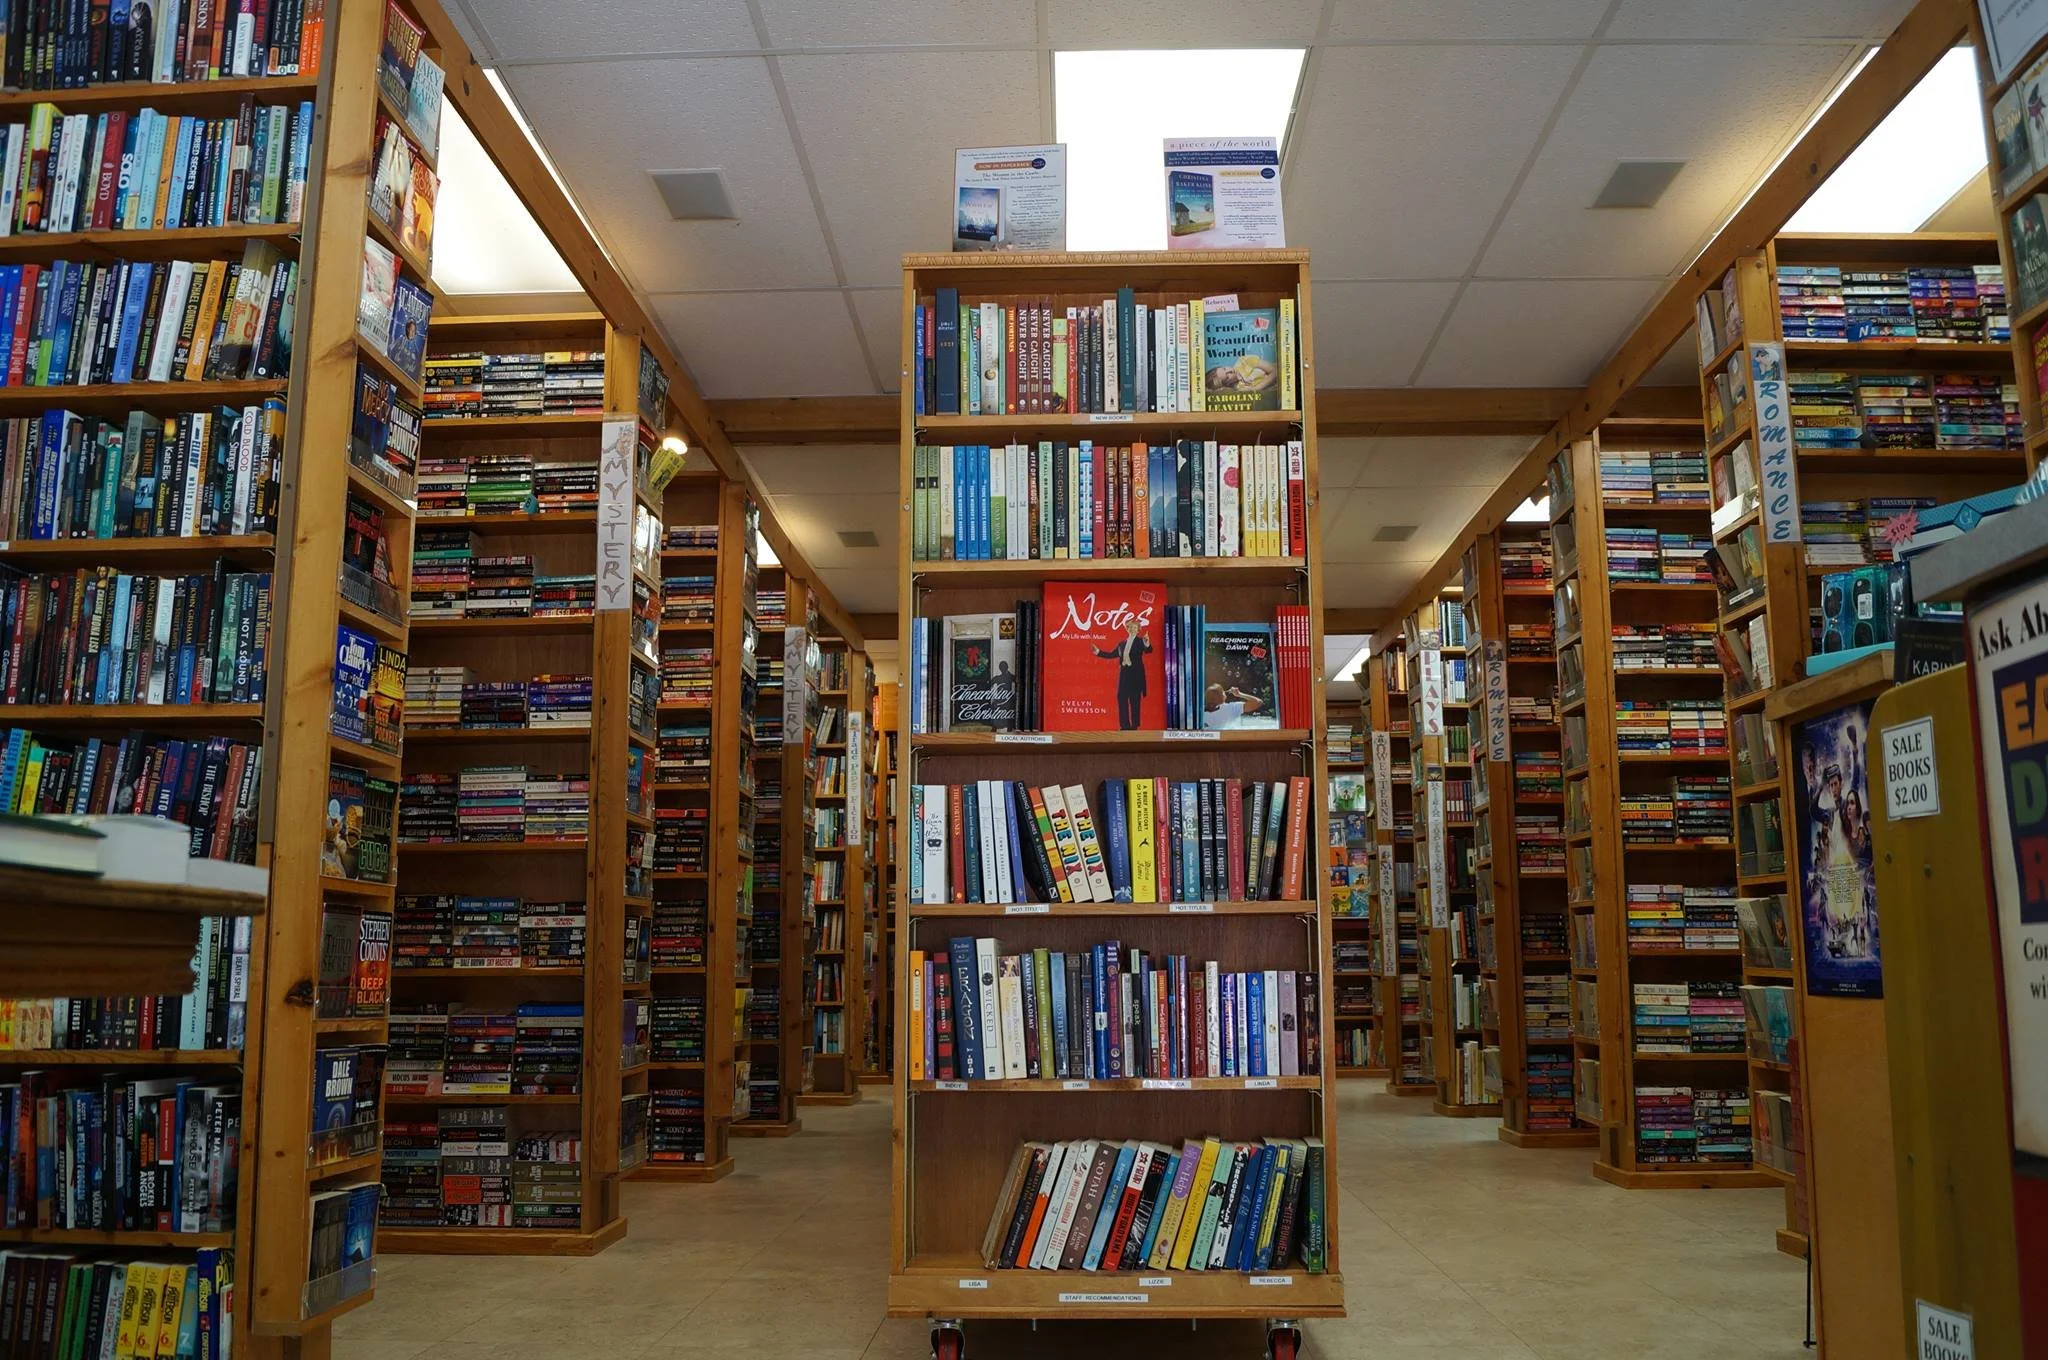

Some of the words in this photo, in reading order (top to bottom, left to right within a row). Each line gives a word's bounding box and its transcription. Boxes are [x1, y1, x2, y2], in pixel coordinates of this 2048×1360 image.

[195, 120, 205, 154] BURIED
[289, 115, 299, 159] INFERNO
[1209, 140, 1221, 148] of
[100, 170, 113, 201] BOYD
[118, 152, 134, 190] SOLO
[187, 155, 201, 191] SECRETS
[193, 274, 204, 303] MICHAEL
[182, 303, 199, 339] CONNELLY
[1207, 323, 1243, 333] Cruel
[1207, 334, 1269, 345] Beautiful
[1207, 348, 1245, 358] World
[1207, 393, 1261, 402] CAROLINE
[1208, 403, 1252, 411] LEAVITT
[243, 411, 254, 436] COLD
[164, 446, 173, 464] Kate
[240, 438, 251, 472] BLOOD
[1759, 382, 1791, 539] ROMANCE
[161, 464, 170, 481] Ellis
[601, 458, 628, 603] MYSTERY
[1292, 504, 1302, 540] YOKOYAMA
[190, 587, 198, 608] JOHN
[257, 589, 269, 618] LITERARY
[185, 610, 196, 643] GRISHAM
[241, 618, 250, 638] NOT
[1050, 593, 1153, 639] Notes
[89, 636, 99, 653] LISA
[349, 636, 365, 659] Tom
[1978, 617, 2012, 661] Ask
[238, 654, 250, 685] SOUND
[340, 644, 371, 677] Clancy's
[380, 648, 407, 671] LINDA
[378, 664, 405, 688] BARNES
[787, 650, 800, 740] MYSTERY
[951, 682, 1015, 703] Unearthing
[1423, 651, 1440, 734] PLAYS
[959, 703, 1016, 721] Christma
[1487, 660, 1505, 760] ROMANCE
[1892, 732, 1922, 757] SALE
[208, 764, 217, 780] THE
[1888, 756, 1931, 782] BOOKS
[158, 789, 171, 812] INTO
[198, 783, 213, 816] BISHOP
[1184, 788, 1195, 806] The
[1202, 783, 1210, 814] UNRAVELING
[1215, 783, 1223, 814] UNRAVELING
[1253, 785, 1262, 814] FRANCINE
[1376, 753, 1389, 826] WESTERNS
[1895, 783, 1928, 807] $2.00
[1052, 808, 1073, 842] THE
[1075, 808, 1095, 842] THE
[1184, 809, 1196, 840] Rocks
[1252, 817, 1260, 835] PROSE
[191, 827, 205, 855] JAMES
[1250, 837, 1258, 860] MISTER
[1060, 843, 1083, 876] NIX
[1083, 843, 1104, 876] NIX
[1248, 861, 1256, 886] MONKEY
[360, 919, 391, 940] STEPHEN
[235, 956, 243, 976] DEATH
[1024, 958, 1032, 991] VAMPIRE
[233, 977, 242, 1000] SPIRAL
[356, 990, 385, 1004] BLACK
[360, 977, 384, 990] DEEP
[958, 967, 975, 1040] ERAGON
[985, 989, 994, 1032] WICKED
[1027, 993, 1035, 1030] ACADEMY
[1133, 999, 1142, 1026] speak
[332, 1060, 351, 1078] DALE
[325, 1077, 353, 1097] BROWN
[214, 1101, 223, 1133] PETER
[213, 1135, 222, 1157] MAY
[140, 1171, 148, 1208] ANGELS
[147, 1170, 155, 1207] BROKEN
[1088, 1159, 1106, 1198] SOTAH
[1173, 1170, 1190, 1194] Help
[1111, 1217, 1130, 1254] YOKOYAMA
[1277, 1221, 1290, 1257] RUNNER
[160, 1333, 168, 1345] 6
[180, 1333, 189, 1345] 7
[1929, 1317, 1960, 1346] SALE
